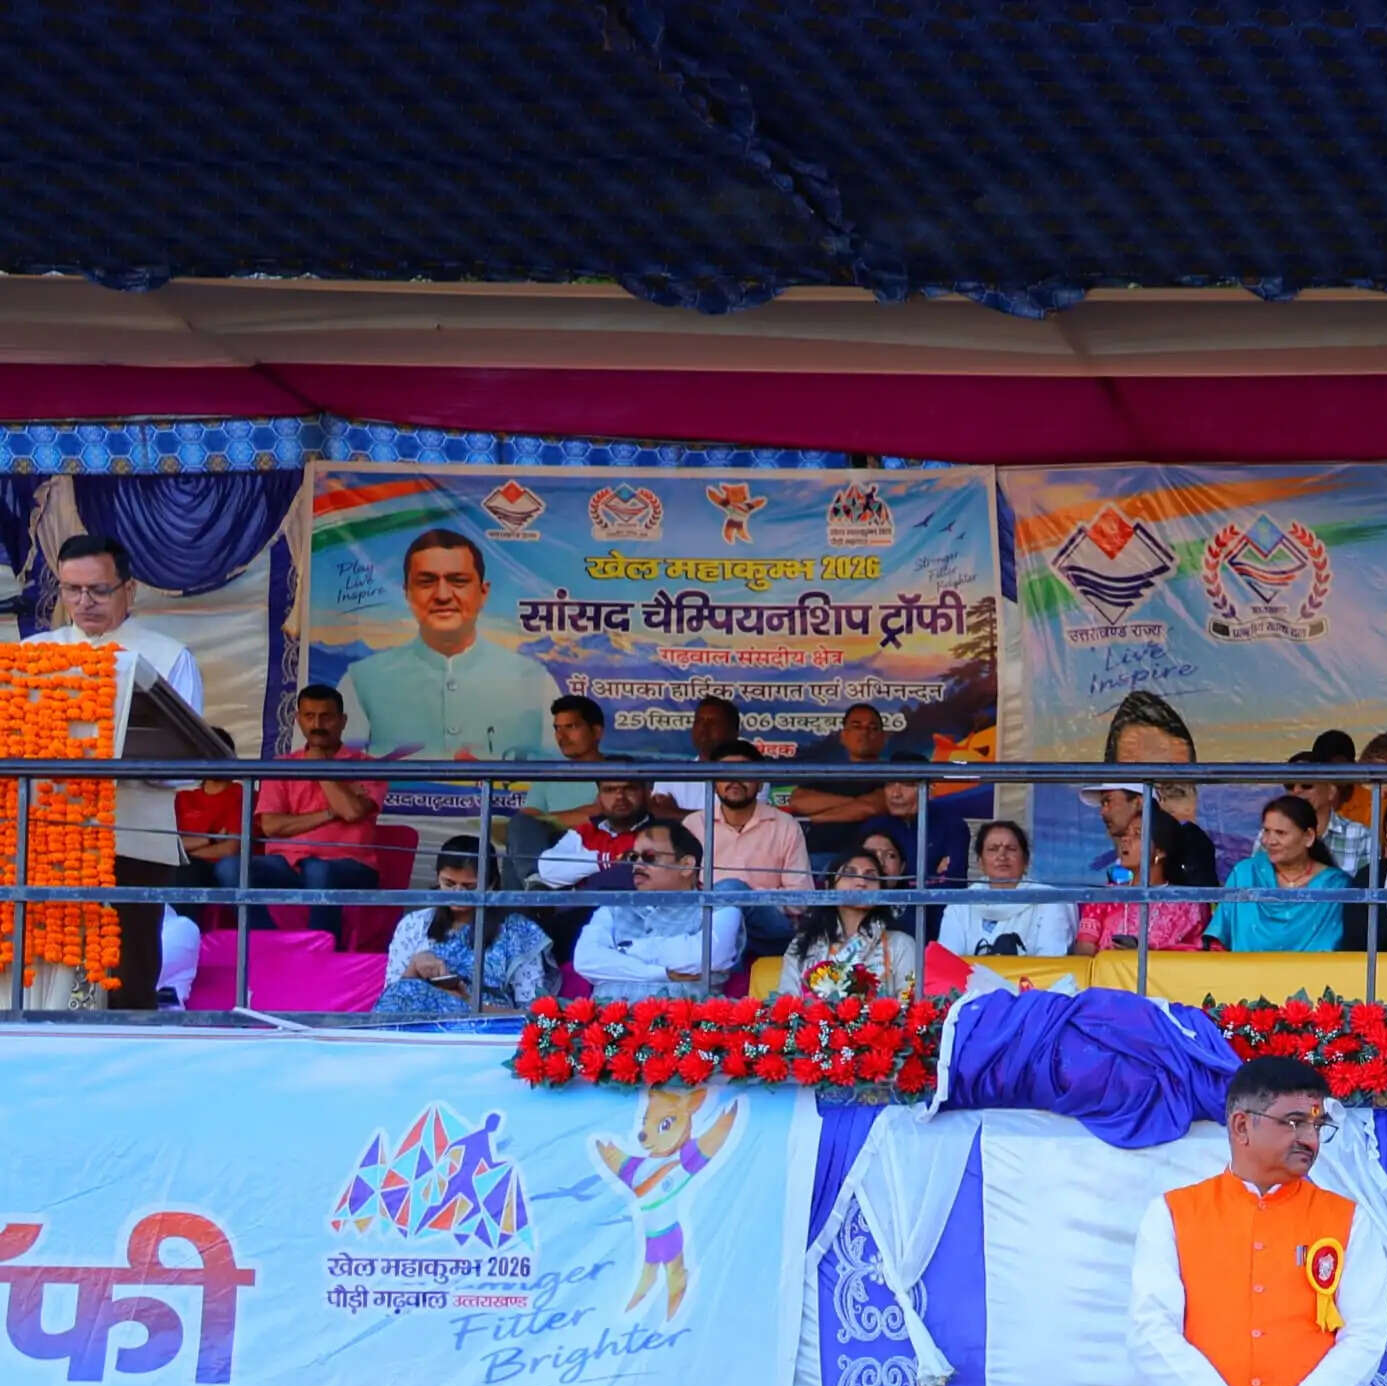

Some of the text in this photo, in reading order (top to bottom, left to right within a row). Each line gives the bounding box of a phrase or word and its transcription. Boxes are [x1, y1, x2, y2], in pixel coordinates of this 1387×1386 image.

[585, 550, 882, 592] खेल महाकुम्भ 2026
[518, 588, 967, 647] सांसद चैम्पियनशिप ट्रॉफी
[660, 649, 729, 670] गढ़वाल
[569, 677, 588, 697] में
[593, 682, 666, 700] आपका
[745, 713, 773, 730] 06
[327, 1252, 531, 1285] खेल महाकुम्भ 2026
[327, 1286, 369, 1315] पौड़ी
[373, 1291, 447, 1316] गढ़वाल
[449, 1305, 597, 1351] Fitter
[480, 1326, 693, 1385] Brighter
